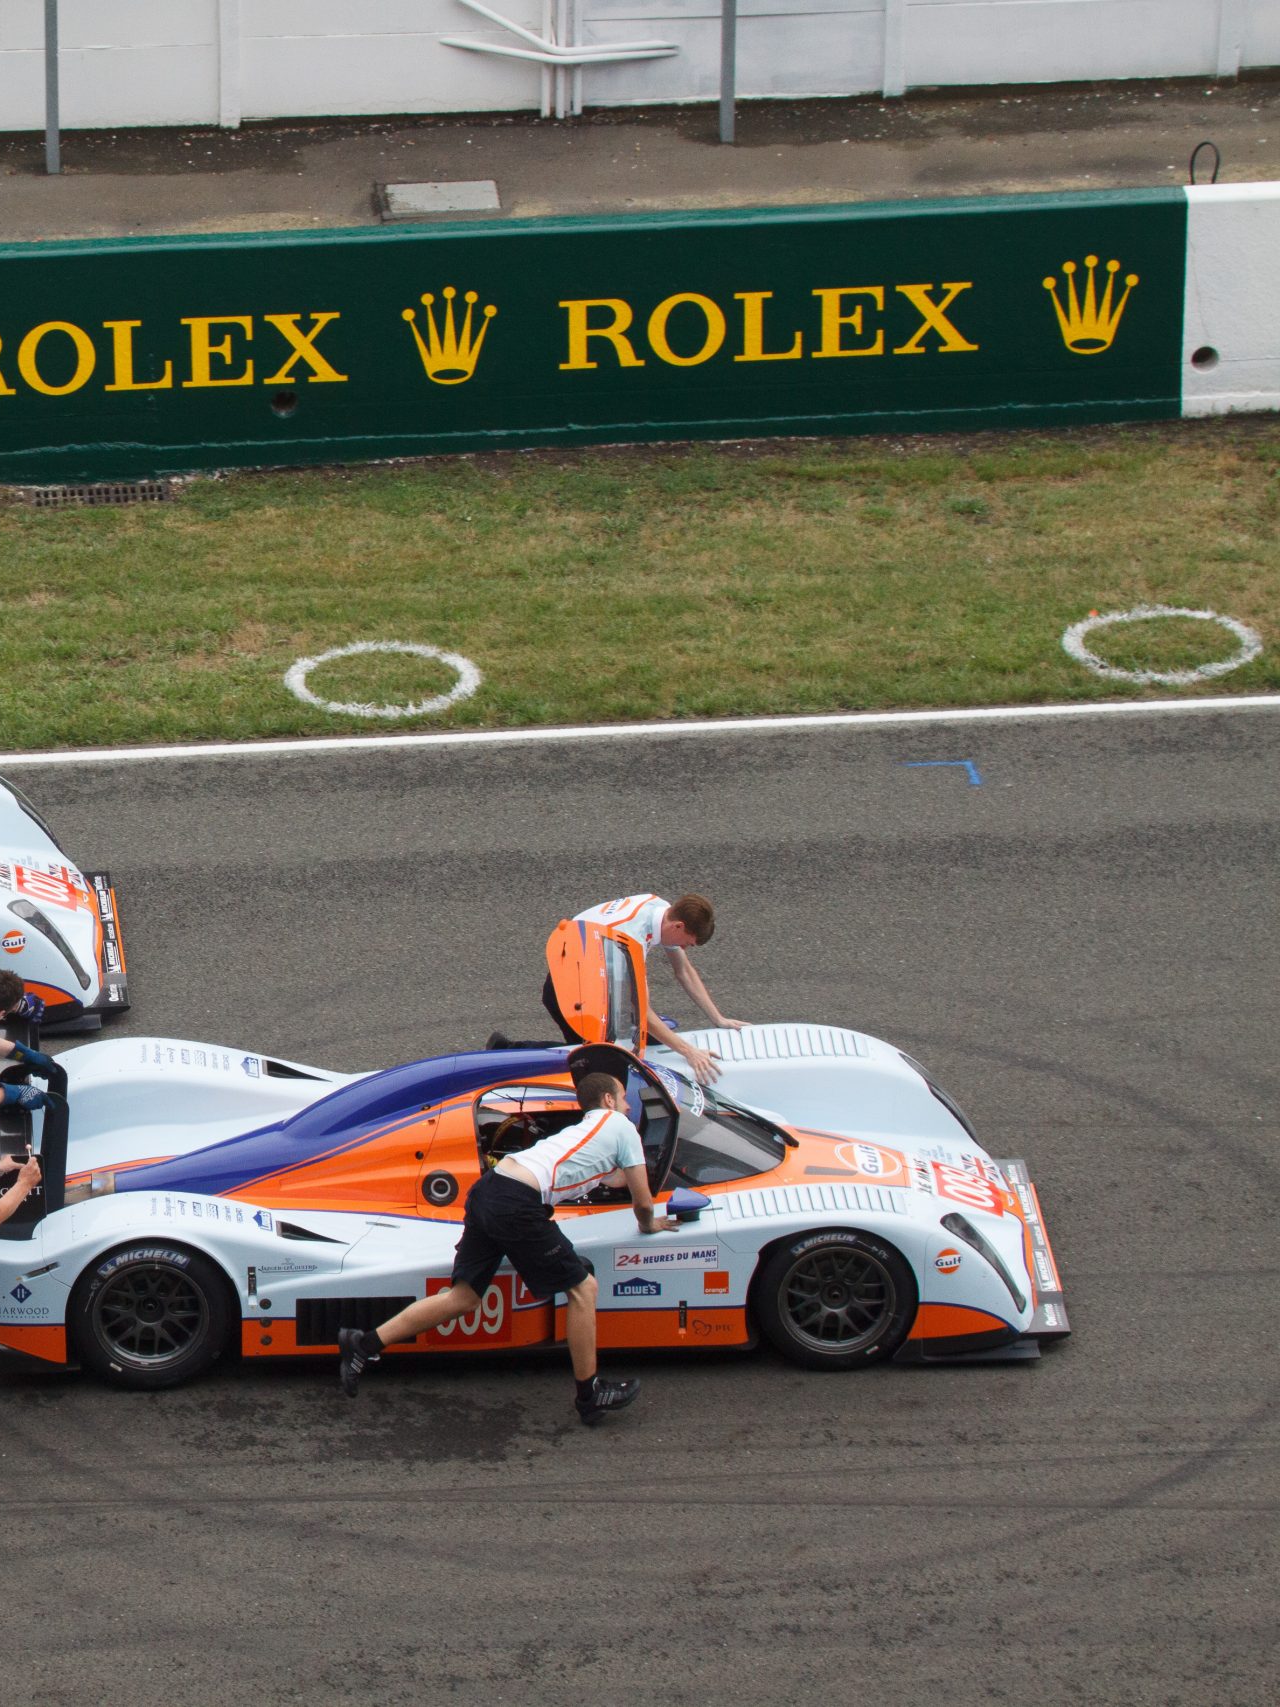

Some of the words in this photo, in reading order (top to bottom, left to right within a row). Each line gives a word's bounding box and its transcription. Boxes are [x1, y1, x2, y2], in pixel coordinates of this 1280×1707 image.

[559, 282, 979, 370] ROLEX
[1, 937, 27, 949] Gulf
[858, 1144, 880, 1175] Gulf
[938, 1165, 995, 1208] 009
[804, 1233, 858, 1248] MICHELIN
[115, 1249, 188, 1266] MICHELIN
[616, 1254, 641, 1267] 24
[643, 1253, 674, 1265] HEURES
[677, 1252, 689, 1260] DU
[691, 1249, 717, 1259] MANS
[935, 1256, 962, 1268] Gulf
[617, 1284, 657, 1295] LOWE'S
